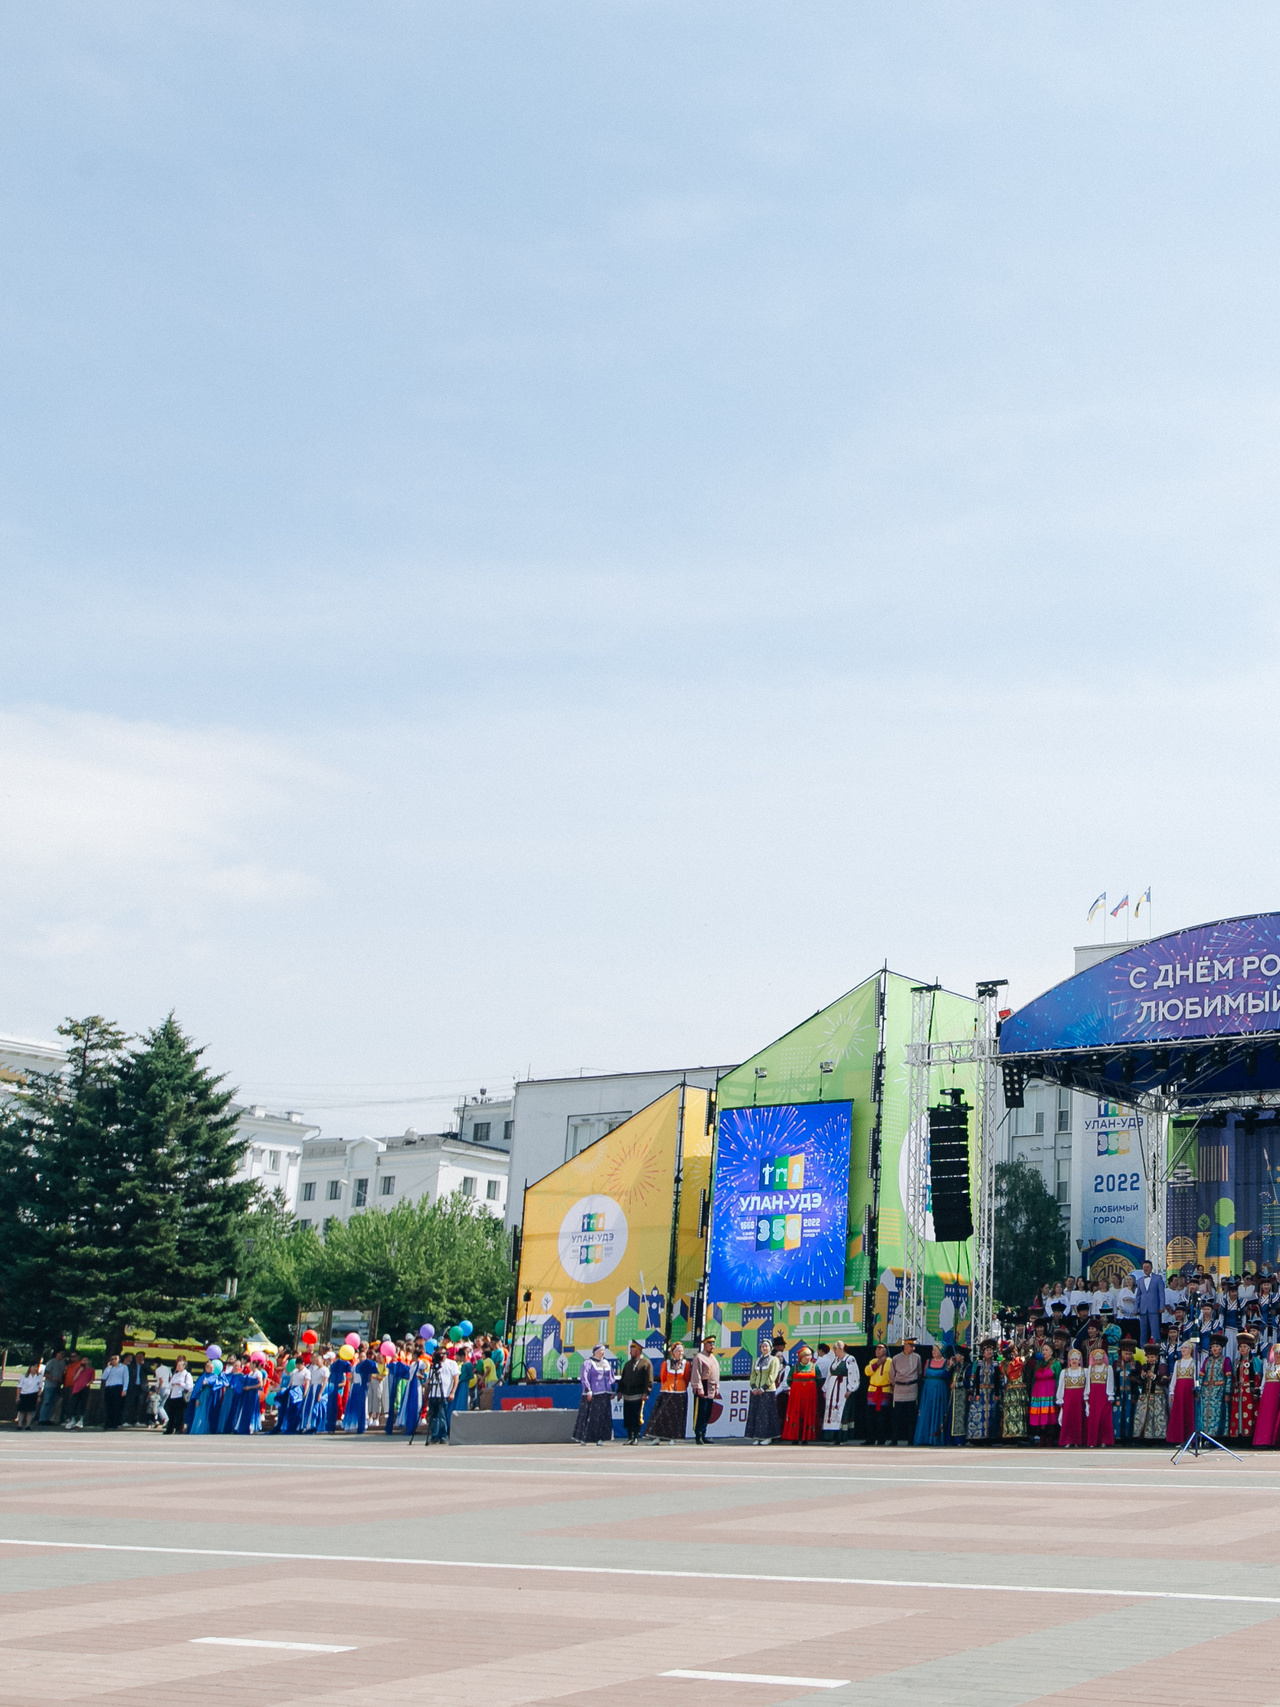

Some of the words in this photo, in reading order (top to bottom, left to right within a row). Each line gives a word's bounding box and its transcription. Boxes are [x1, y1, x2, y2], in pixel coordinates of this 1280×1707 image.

[1128, 966, 1147, 990] С
[1153, 956, 1235, 990] ДНЁМ
[1084, 1117, 1144, 1130] УЛАН-УДЭ
[1094, 1172, 1140, 1193] 2022
[739, 1193, 822, 1212] УЛАН-УДЭ
[1093, 1202, 1139, 1213] ЛЮБИМЫЙ
[802, 1217, 821, 1227] 2022
[1093, 1215, 1125, 1225] ГОРОД!
[571, 1233, 615, 1243] УЛАН-УДЭ
